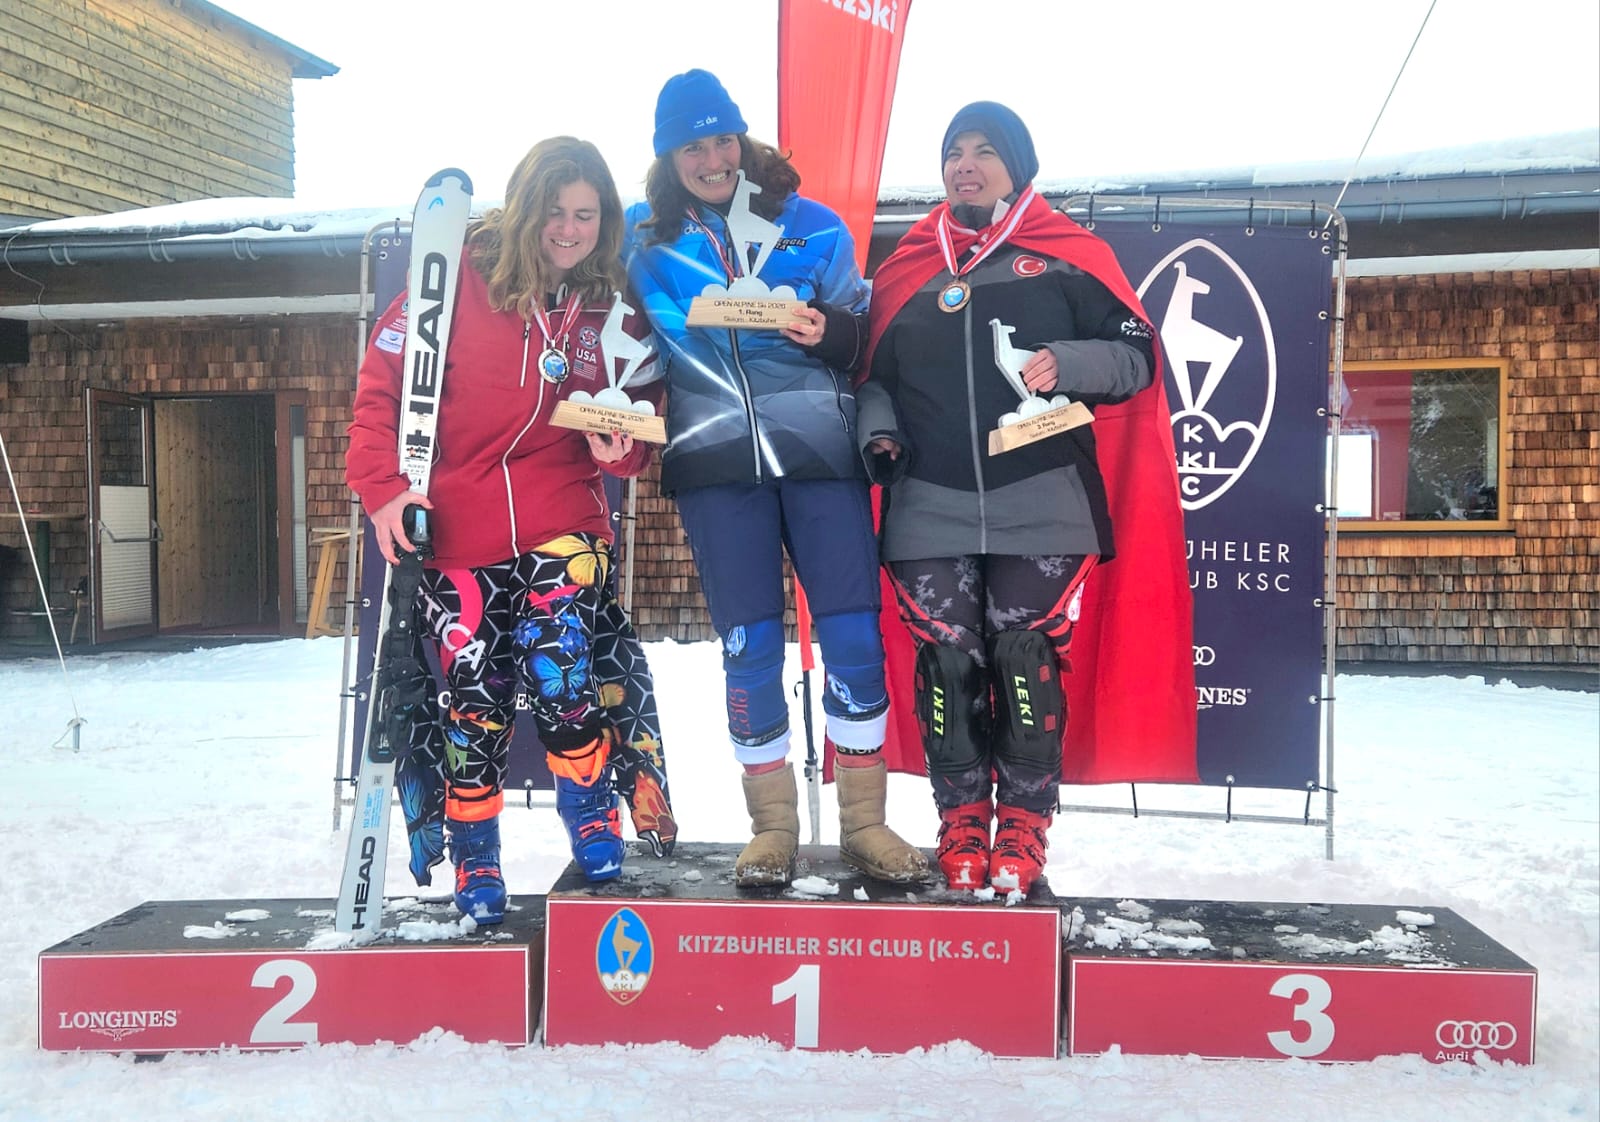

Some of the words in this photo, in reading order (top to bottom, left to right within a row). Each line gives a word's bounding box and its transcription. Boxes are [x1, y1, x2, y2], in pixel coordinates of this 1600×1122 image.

[406, 252, 448, 448] HEAD
[576, 348, 597, 363] USA
[1183, 423, 1204, 444] K
[1175, 450, 1216, 470] KI
[1181, 476, 1200, 496] C
[1237, 572, 1290, 592] KSC
[1014, 675, 1035, 726] LEKI
[1195, 686, 1248, 706] NES
[933, 686, 945, 736] LEKI
[352, 836, 376, 930] HEAD
[678, 935, 821, 957] KITZBÜHELER
[827, 938, 863, 957] SKI
[869, 939, 923, 958] CLUB
[929, 938, 1011, 964] (K.S.C.)
[250, 959, 318, 1043] 2
[772, 964, 820, 1048] 1
[59, 1010, 178, 1029] LONGINES
[1266, 974, 1336, 1057] 3
[1435, 1050, 1469, 1062] Audi
